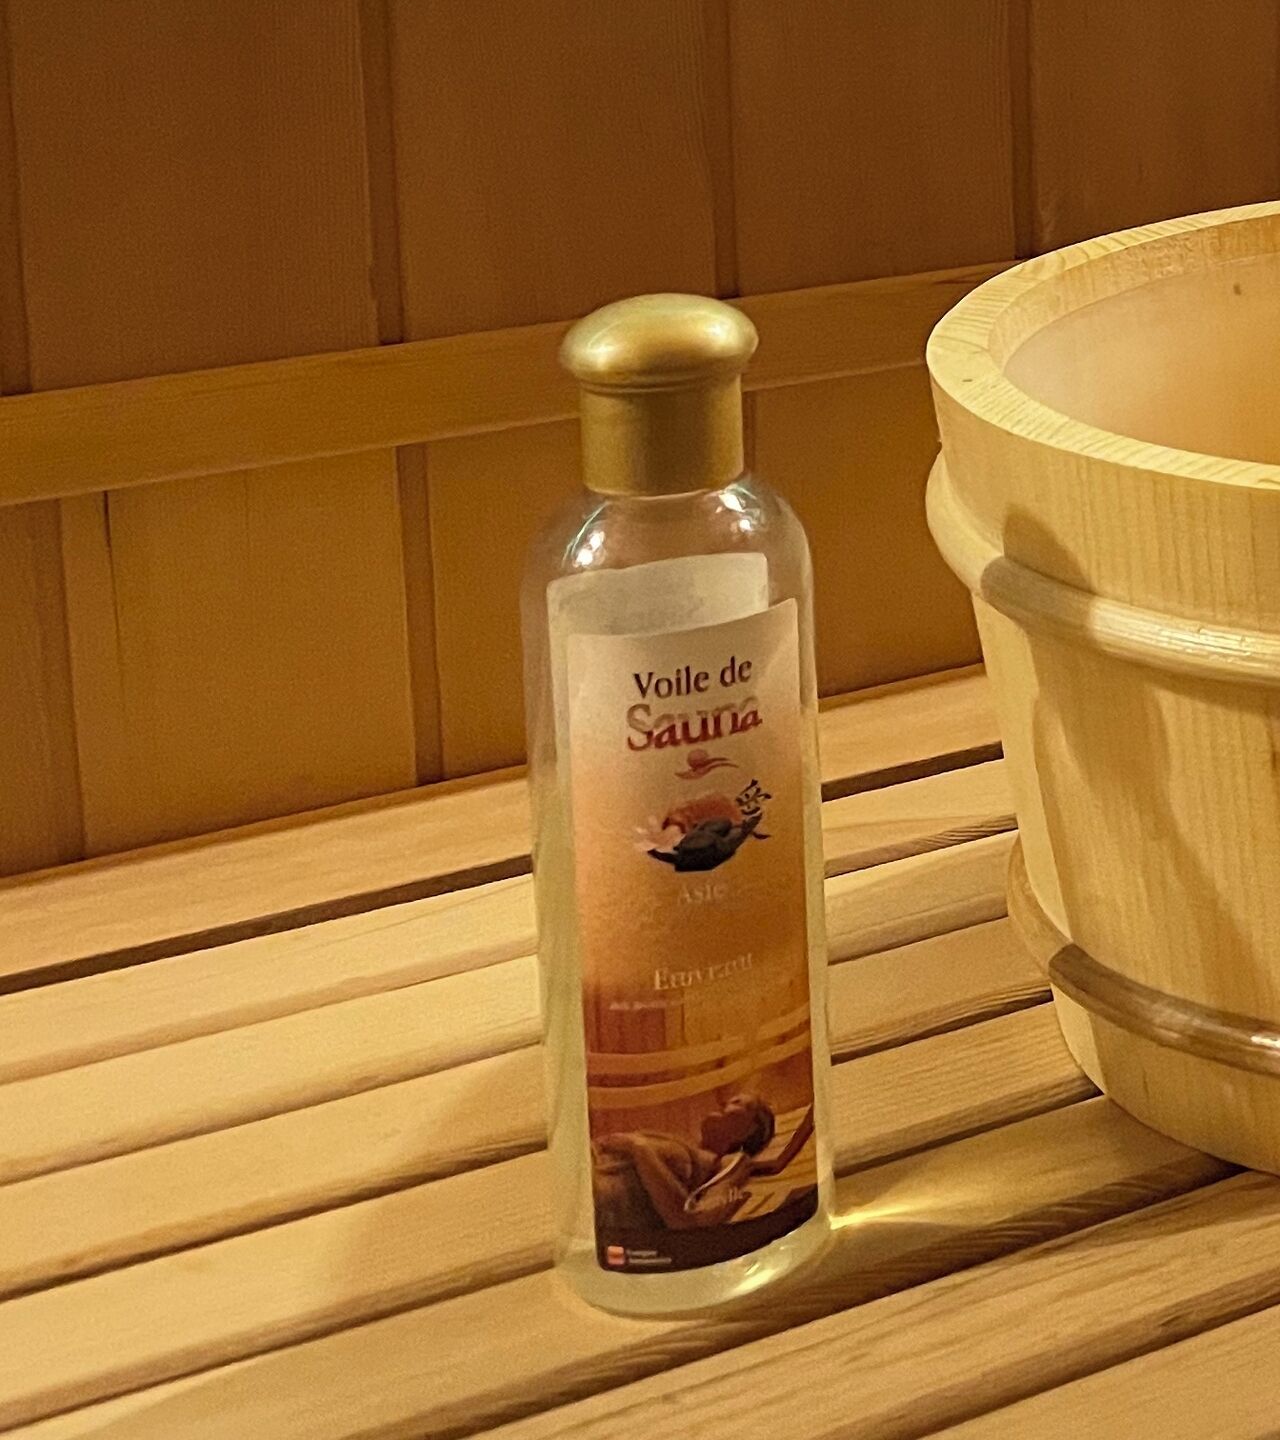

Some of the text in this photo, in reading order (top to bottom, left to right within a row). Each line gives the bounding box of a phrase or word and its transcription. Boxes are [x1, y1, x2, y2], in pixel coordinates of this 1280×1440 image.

[632, 655, 752, 699] Voile de
[626, 695, 763, 751] Sauna
